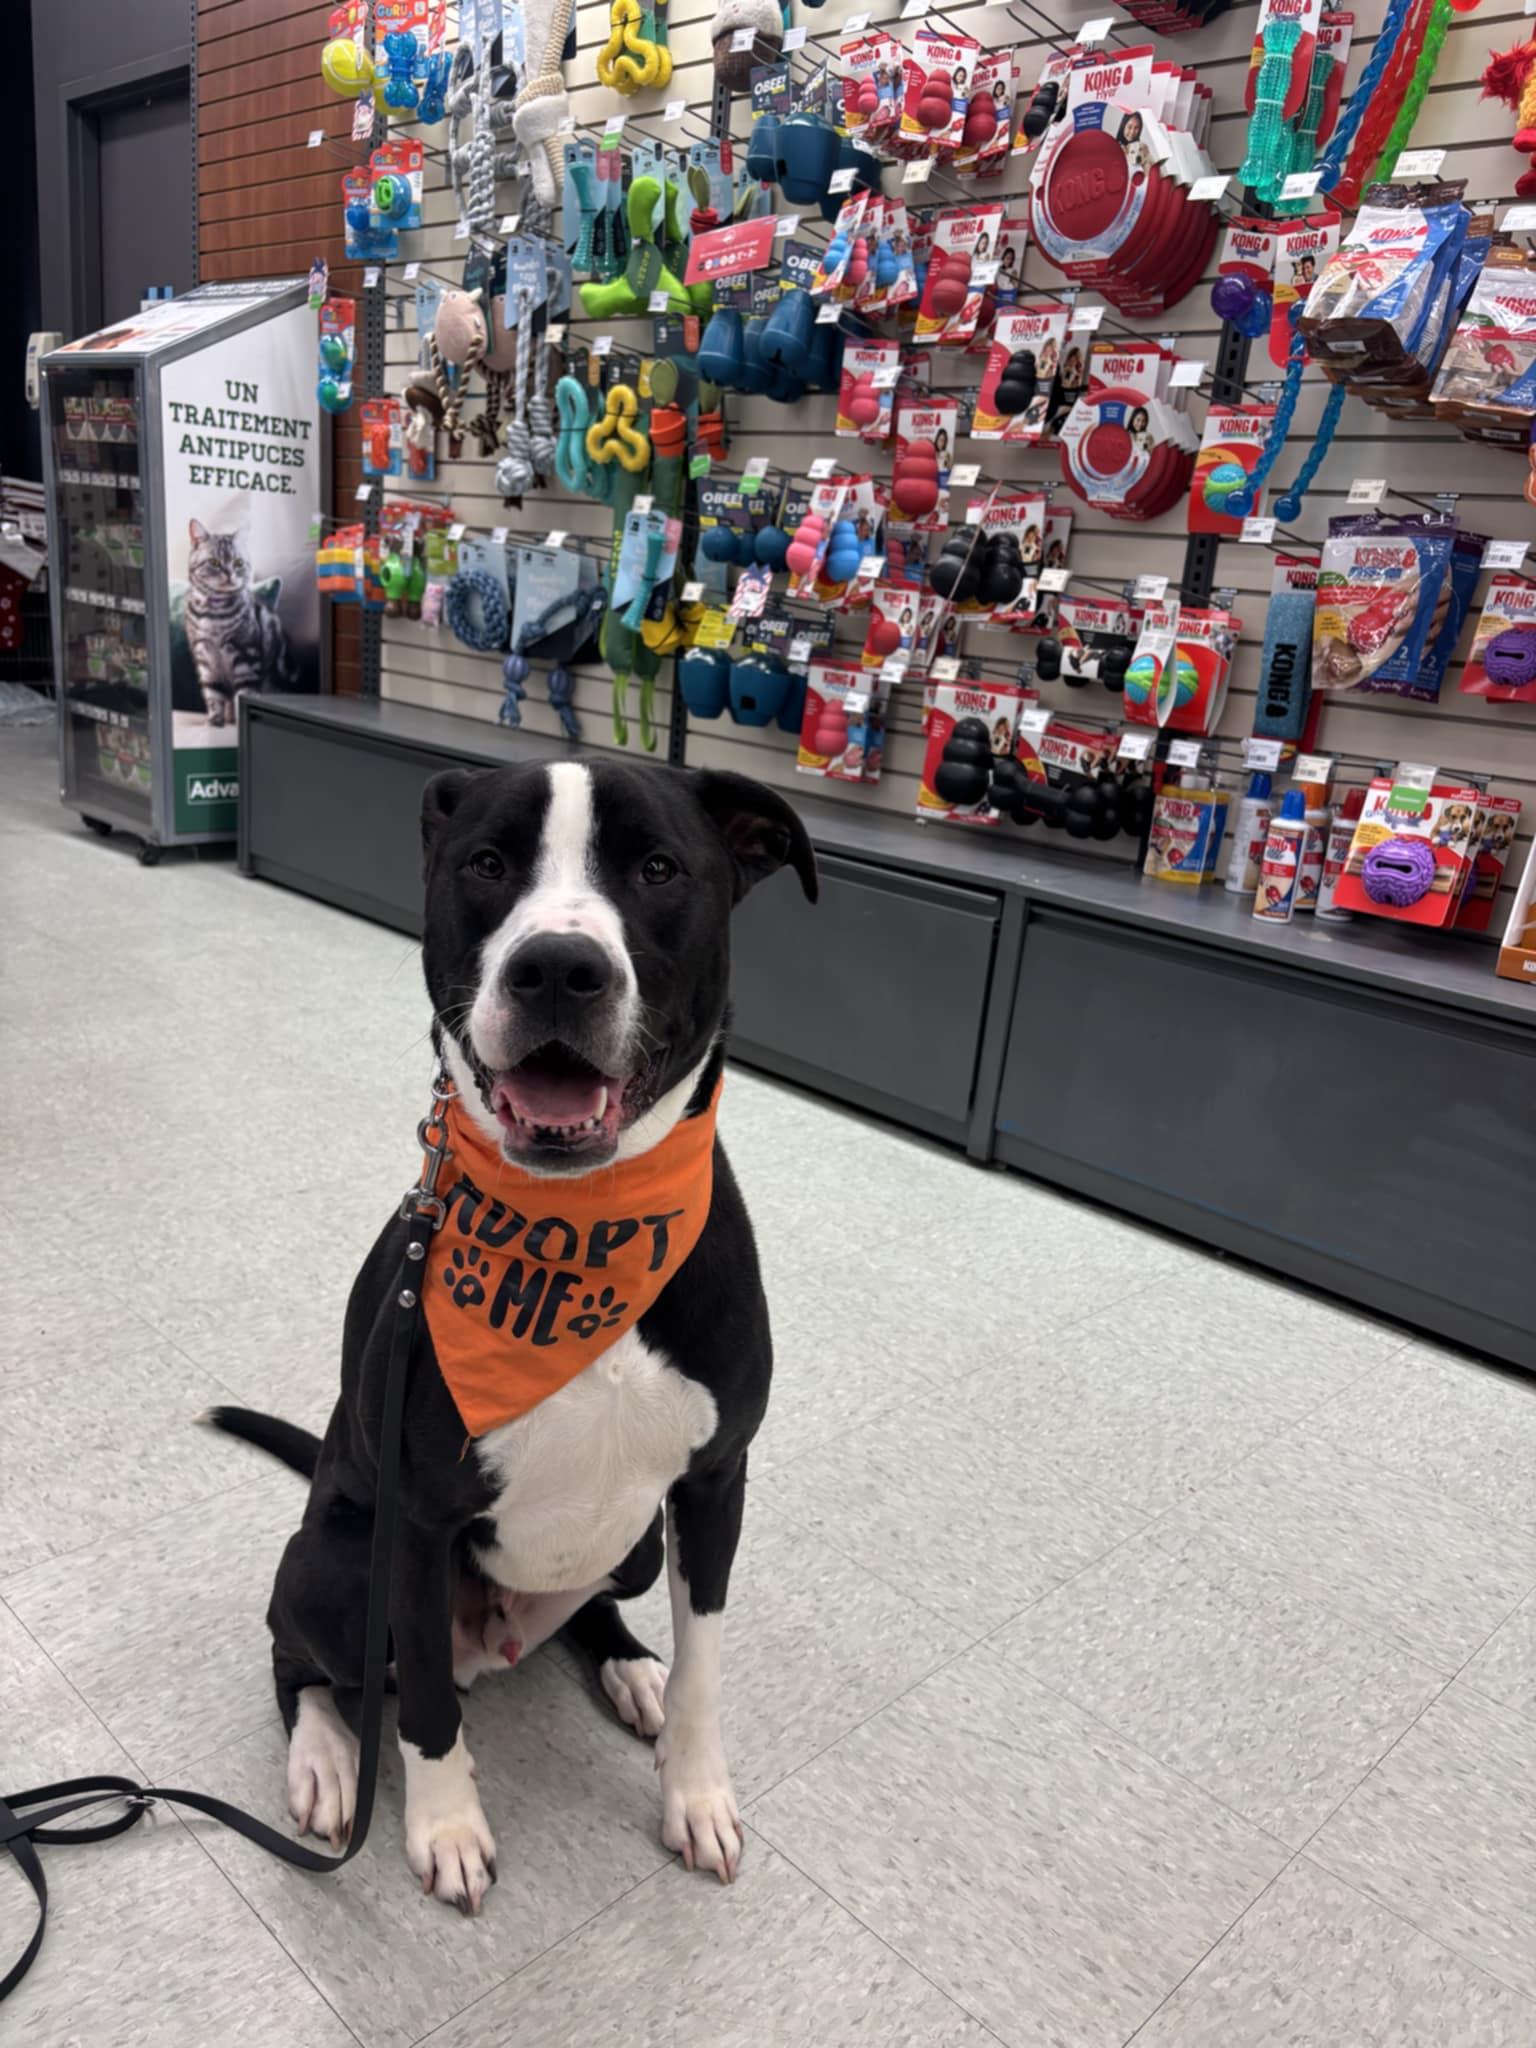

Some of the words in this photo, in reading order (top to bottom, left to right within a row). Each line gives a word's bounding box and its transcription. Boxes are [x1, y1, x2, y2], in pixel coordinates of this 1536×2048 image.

[850, 49, 874, 66] KONG
[927, 45, 955, 60] KONG
[754, 75, 786, 95] OBEE!
[1083, 67, 1121, 92] KONG
[951, 220, 977, 237] KONG
[1368, 227, 1416, 241] KONG
[1231, 233, 1260, 250] KONG
[1286, 233, 1318, 253] KONG
[715, 273, 747, 290] OBEE!
[1011, 318, 1041, 335] KONG
[1103, 359, 1135, 374] KONG
[225, 380, 259, 404] UN
[169, 402, 312, 440] TRAITEMENT
[1219, 419, 1250, 433] KONG
[179, 433, 305, 468] ANTIPUCES
[189, 464, 297, 495] EFFICACE.
[702, 491, 743, 505] OBEE!
[1286, 570, 1317, 585] KONG
[1494, 591, 1536, 610] KONG
[1075, 609, 1100, 624] KONG
[759, 619, 788, 633] OBEE!
[1399, 646, 1408, 659] 2
[1267, 643, 1297, 703] KONG
[954, 690, 988, 710] KONG
[1040, 737, 1069, 758] KONG
[190, 779, 240, 799] Adva
[446, 1172, 685, 1272] ADOPT
[489, 1258, 583, 1346] ME
